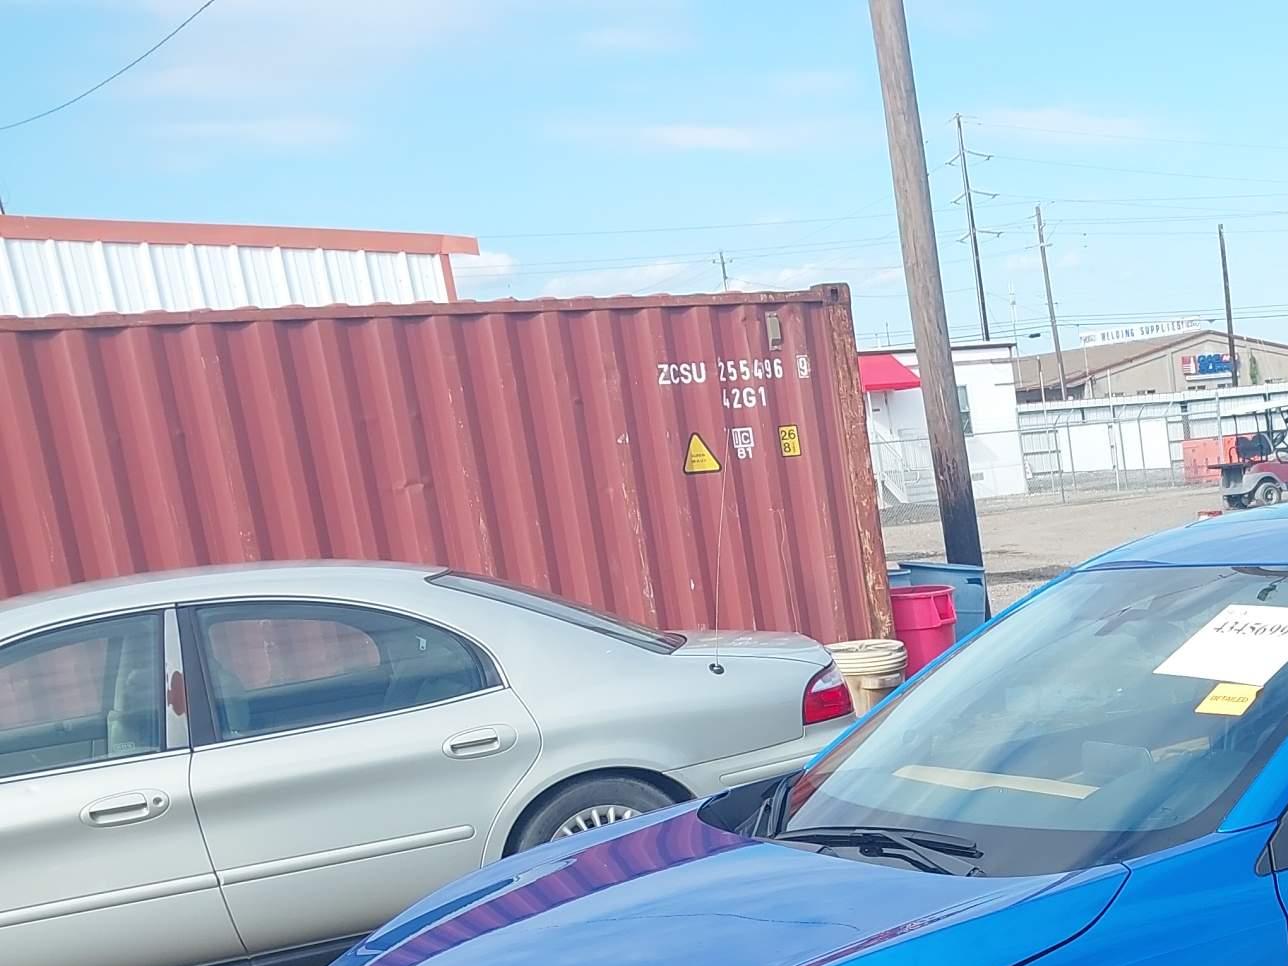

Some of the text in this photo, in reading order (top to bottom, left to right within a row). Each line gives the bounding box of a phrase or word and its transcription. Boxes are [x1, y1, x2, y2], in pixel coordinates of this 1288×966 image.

[657, 362, 706, 385] ZCSU
[718, 359, 783, 382] 255496
[723, 386, 767, 409] 42G1
[781, 429, 796, 440] 26
[738, 447, 753, 459] 81
